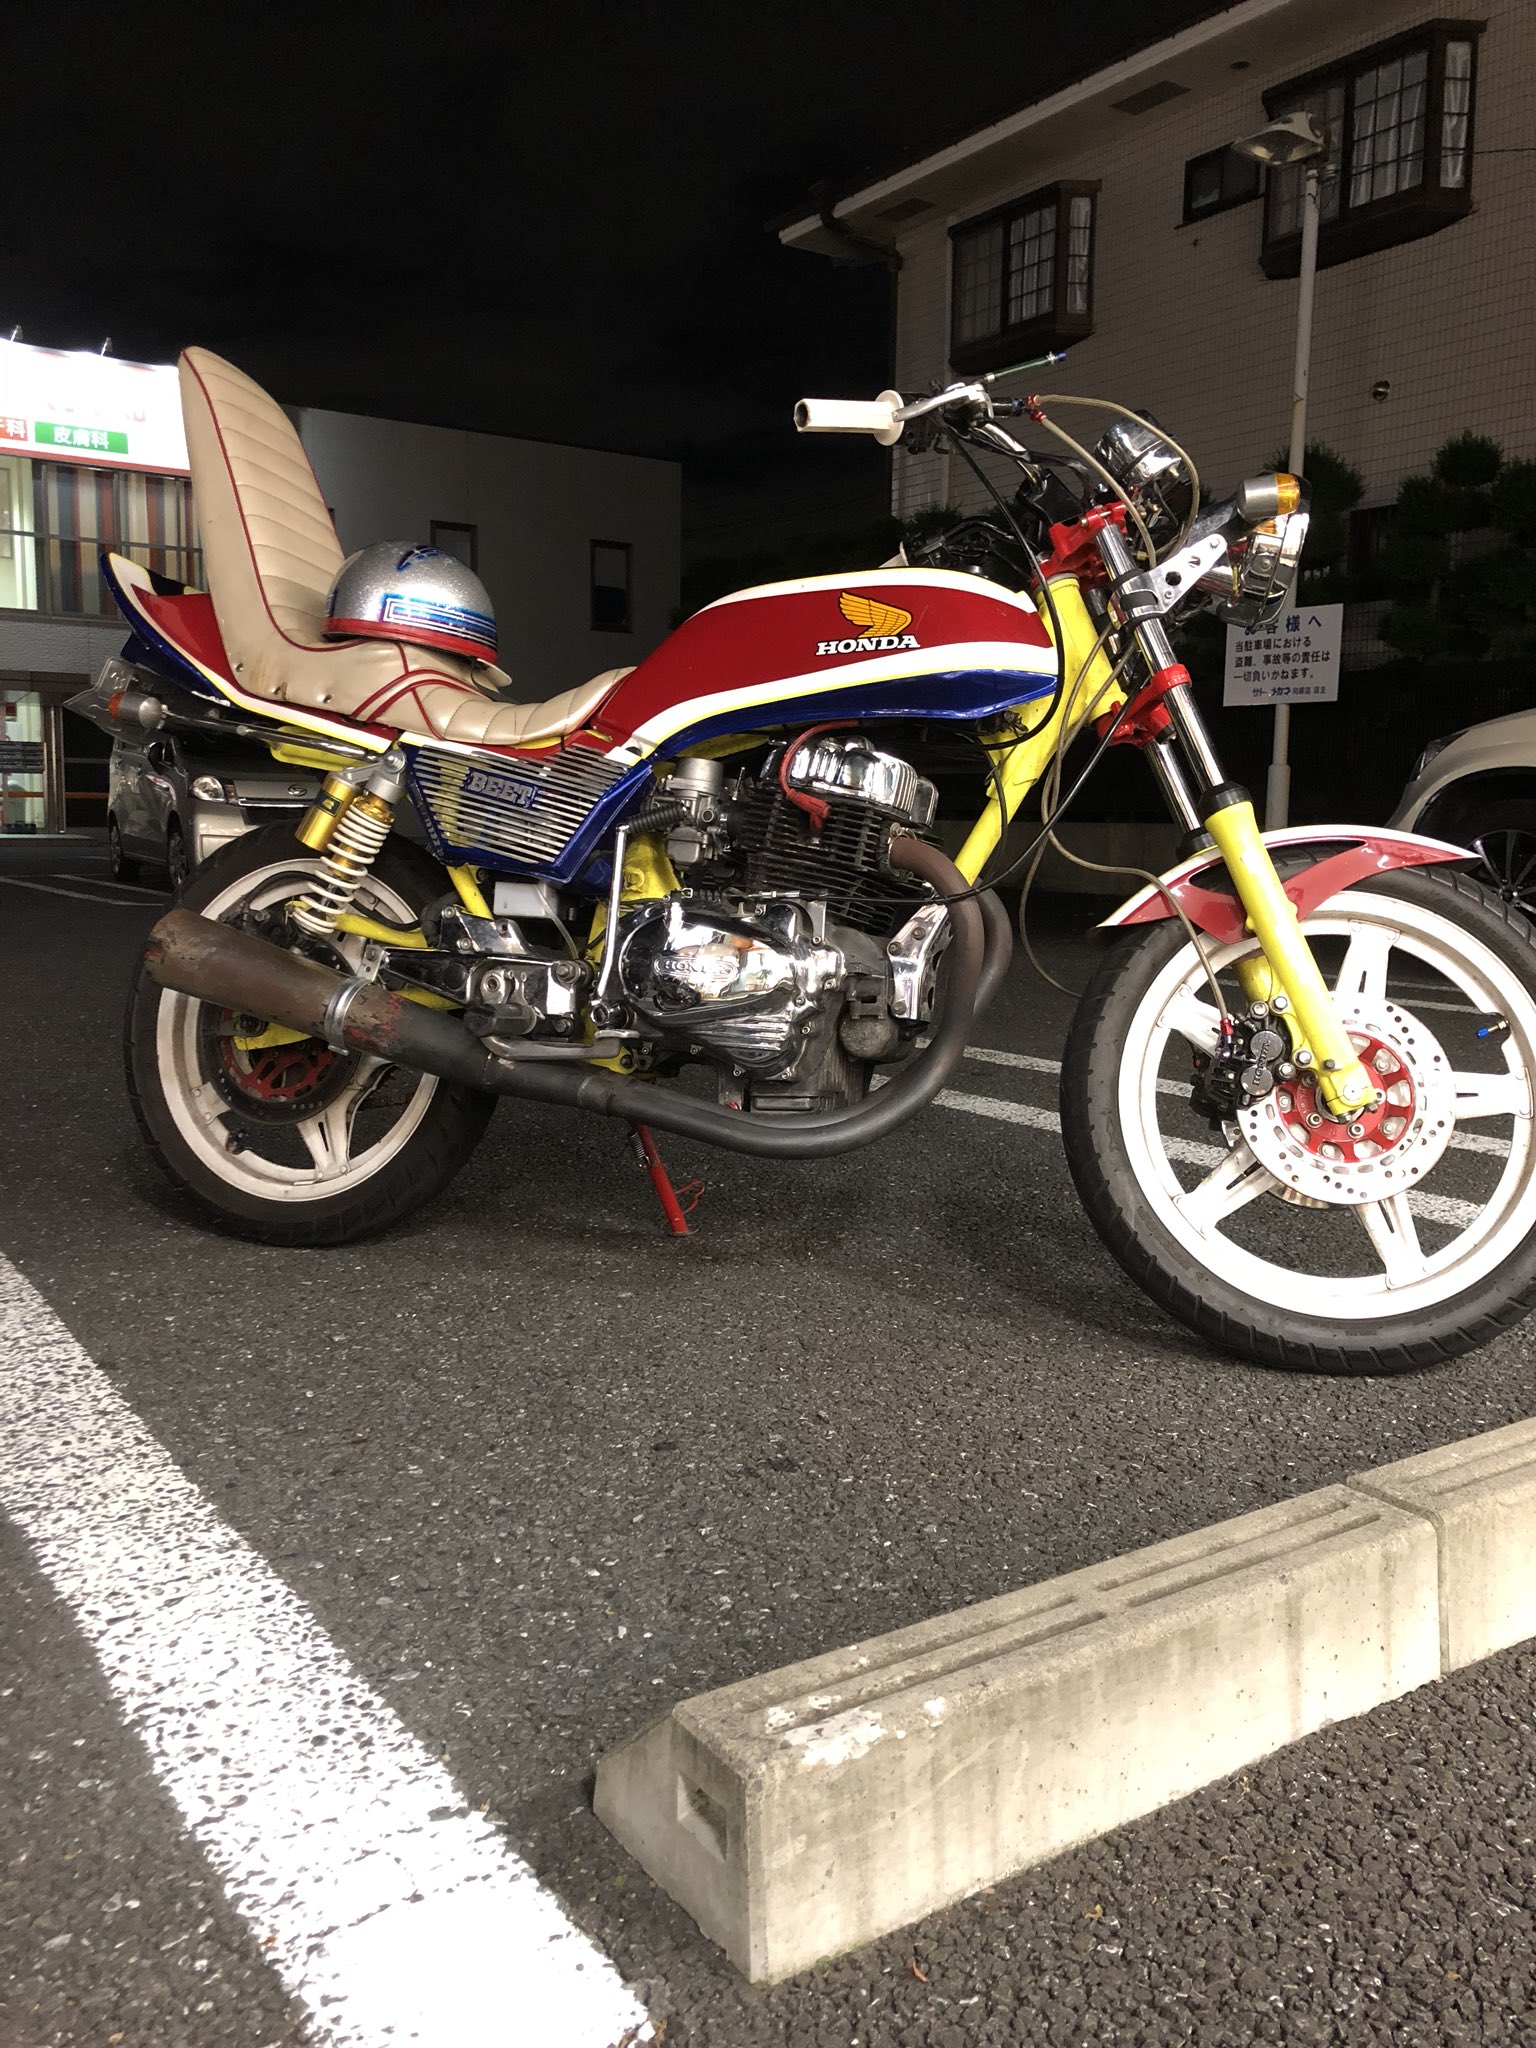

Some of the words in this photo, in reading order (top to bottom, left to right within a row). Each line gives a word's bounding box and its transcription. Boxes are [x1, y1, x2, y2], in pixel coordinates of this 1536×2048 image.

[53, 426, 109, 450] 皮膚科
[816, 635, 921, 656] HONDA
[1235, 636, 1312, 653] 当駐車場における
[1234, 667, 1314, 682] 一切負いかねます。
[468, 771, 533, 805] BEET
